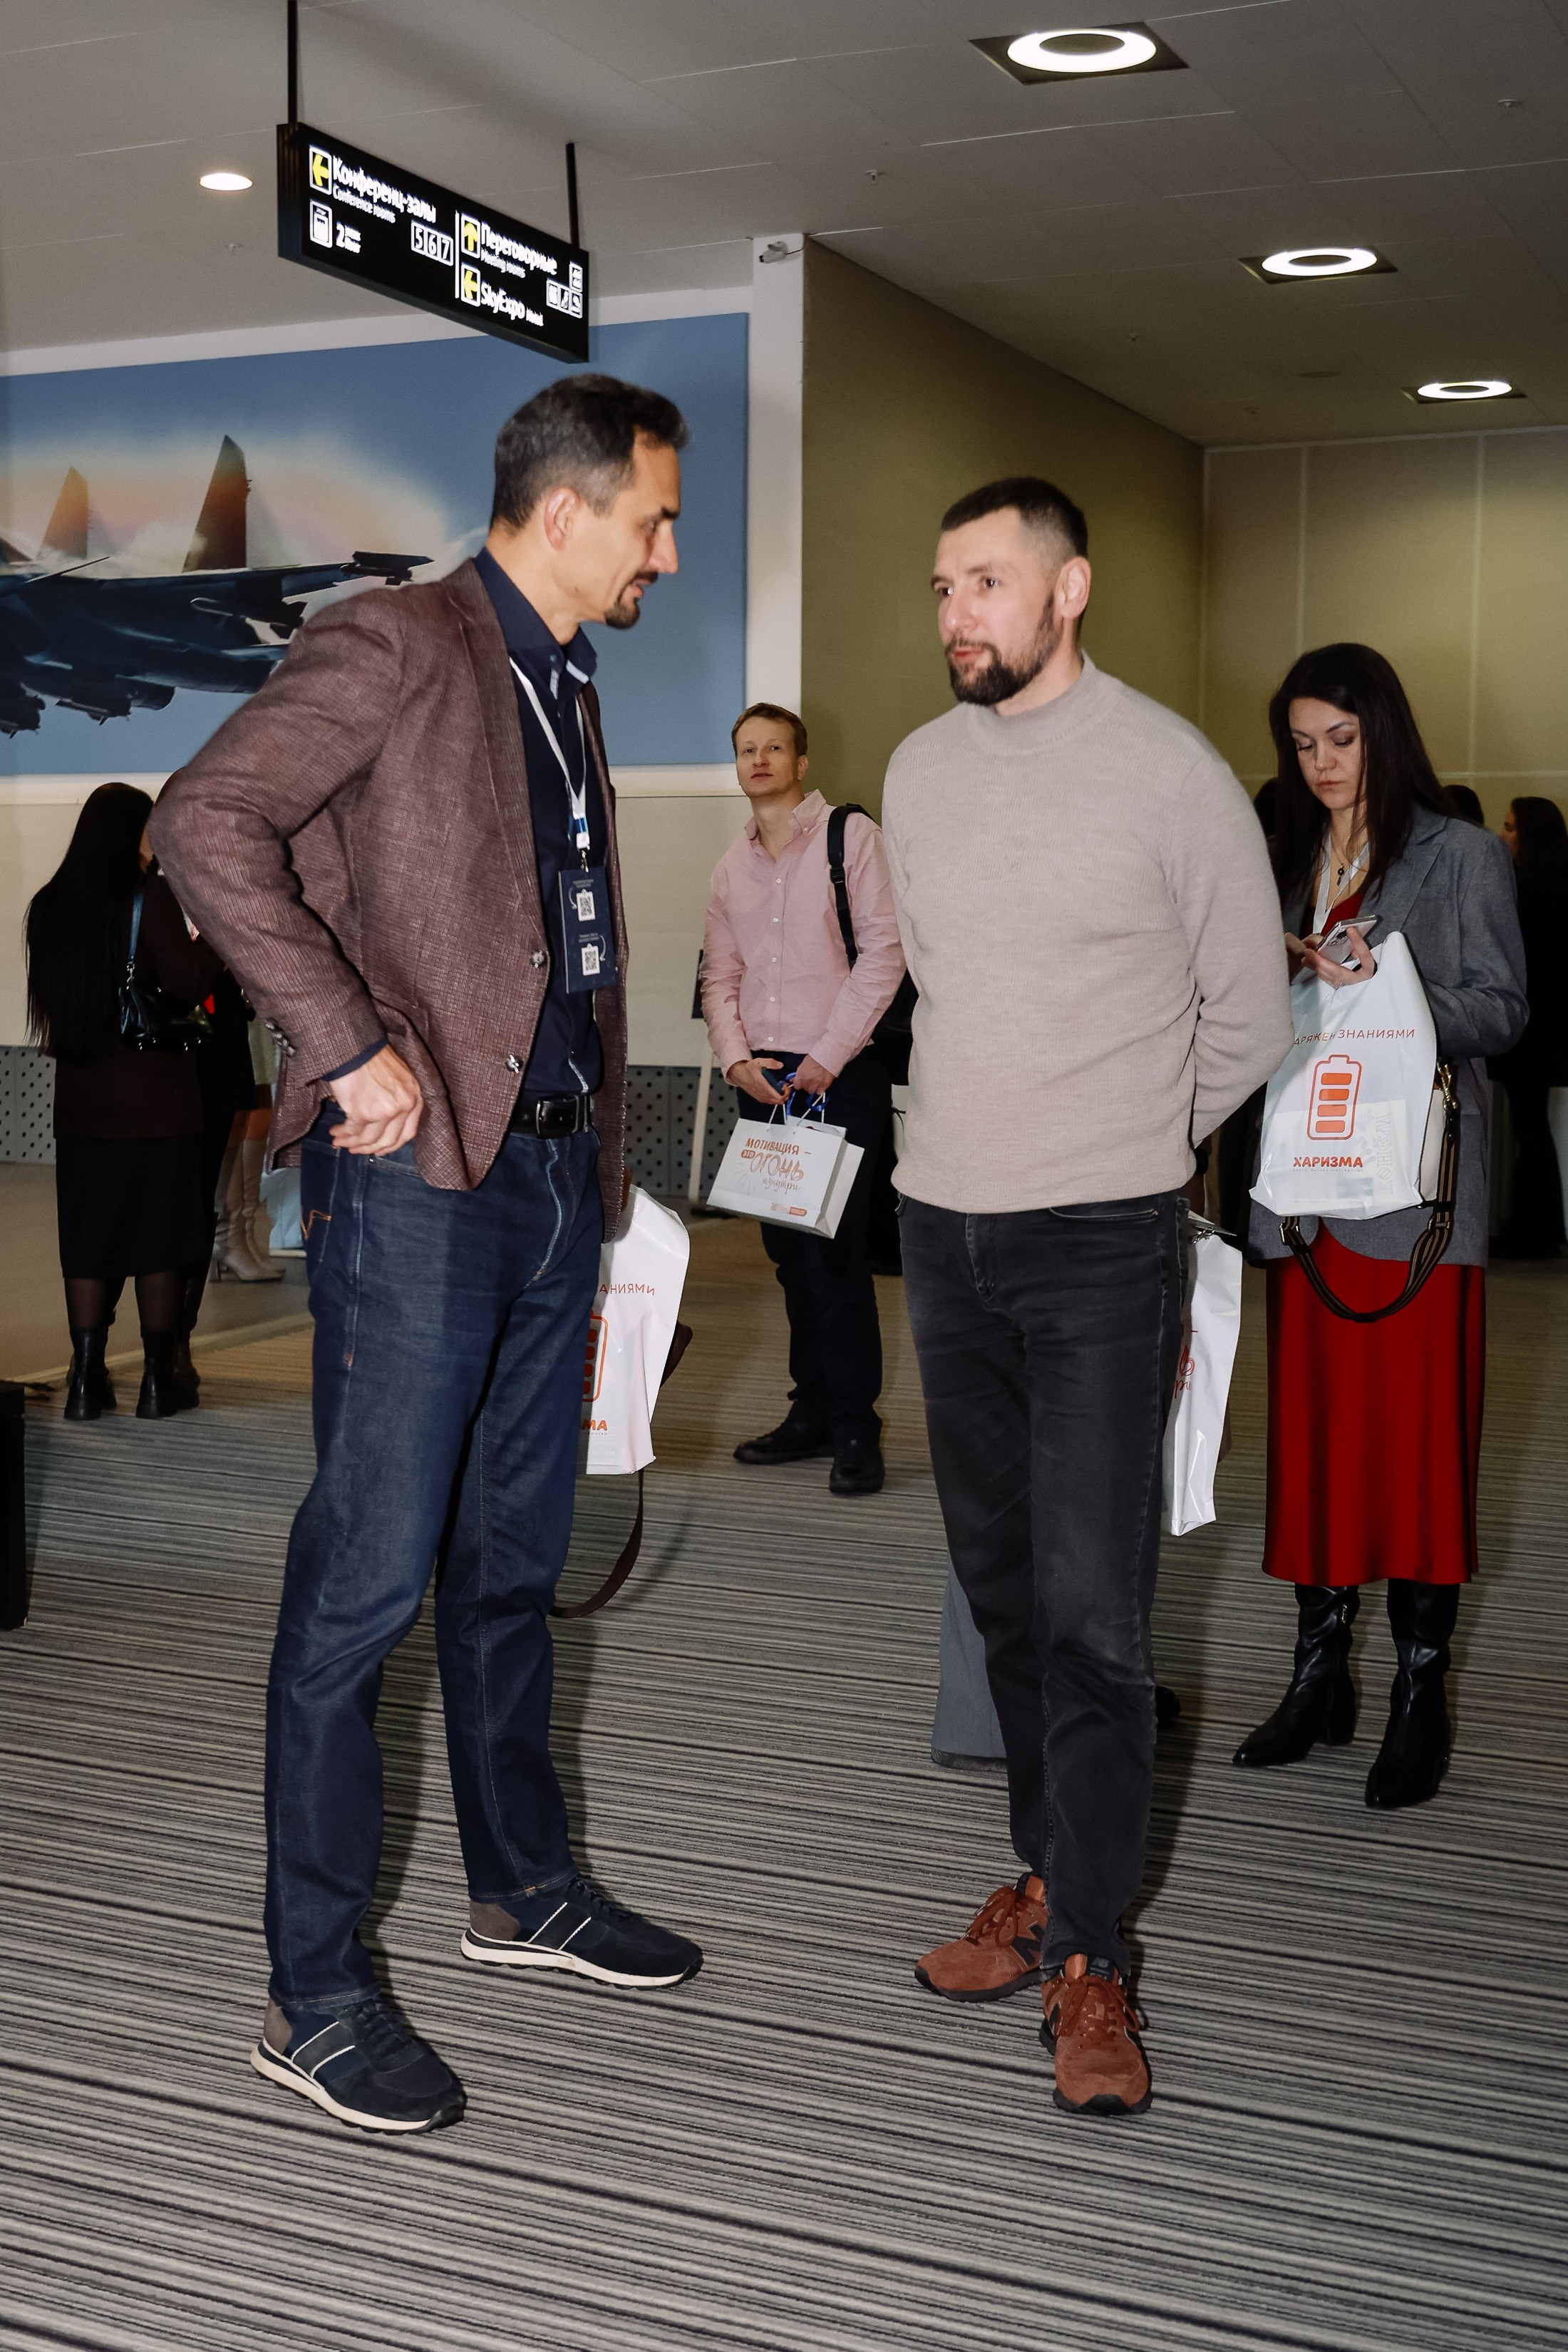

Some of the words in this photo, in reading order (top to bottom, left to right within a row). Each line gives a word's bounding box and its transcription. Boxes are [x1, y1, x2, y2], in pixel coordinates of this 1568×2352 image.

[333, 155, 437, 223] Конференц-залы
[336, 221, 345, 248] 2
[414, 227, 423, 249] 5
[428, 234, 437, 256] 6
[441, 239, 450, 260] 7
[480, 222, 558, 276] Переговорные
[480, 281, 525, 321] SkyExpo
[1294, 1031, 1336, 1046] АРЯЖЕН
[1337, 1028, 1415, 1039] ЗНАНИЯМИ
[746, 1138, 800, 1155] МОТИВАЦИЯ
[1293, 1156, 1363, 1167] ХАРИЗМА
[599, 1283, 656, 1296] АНИЯМИ
